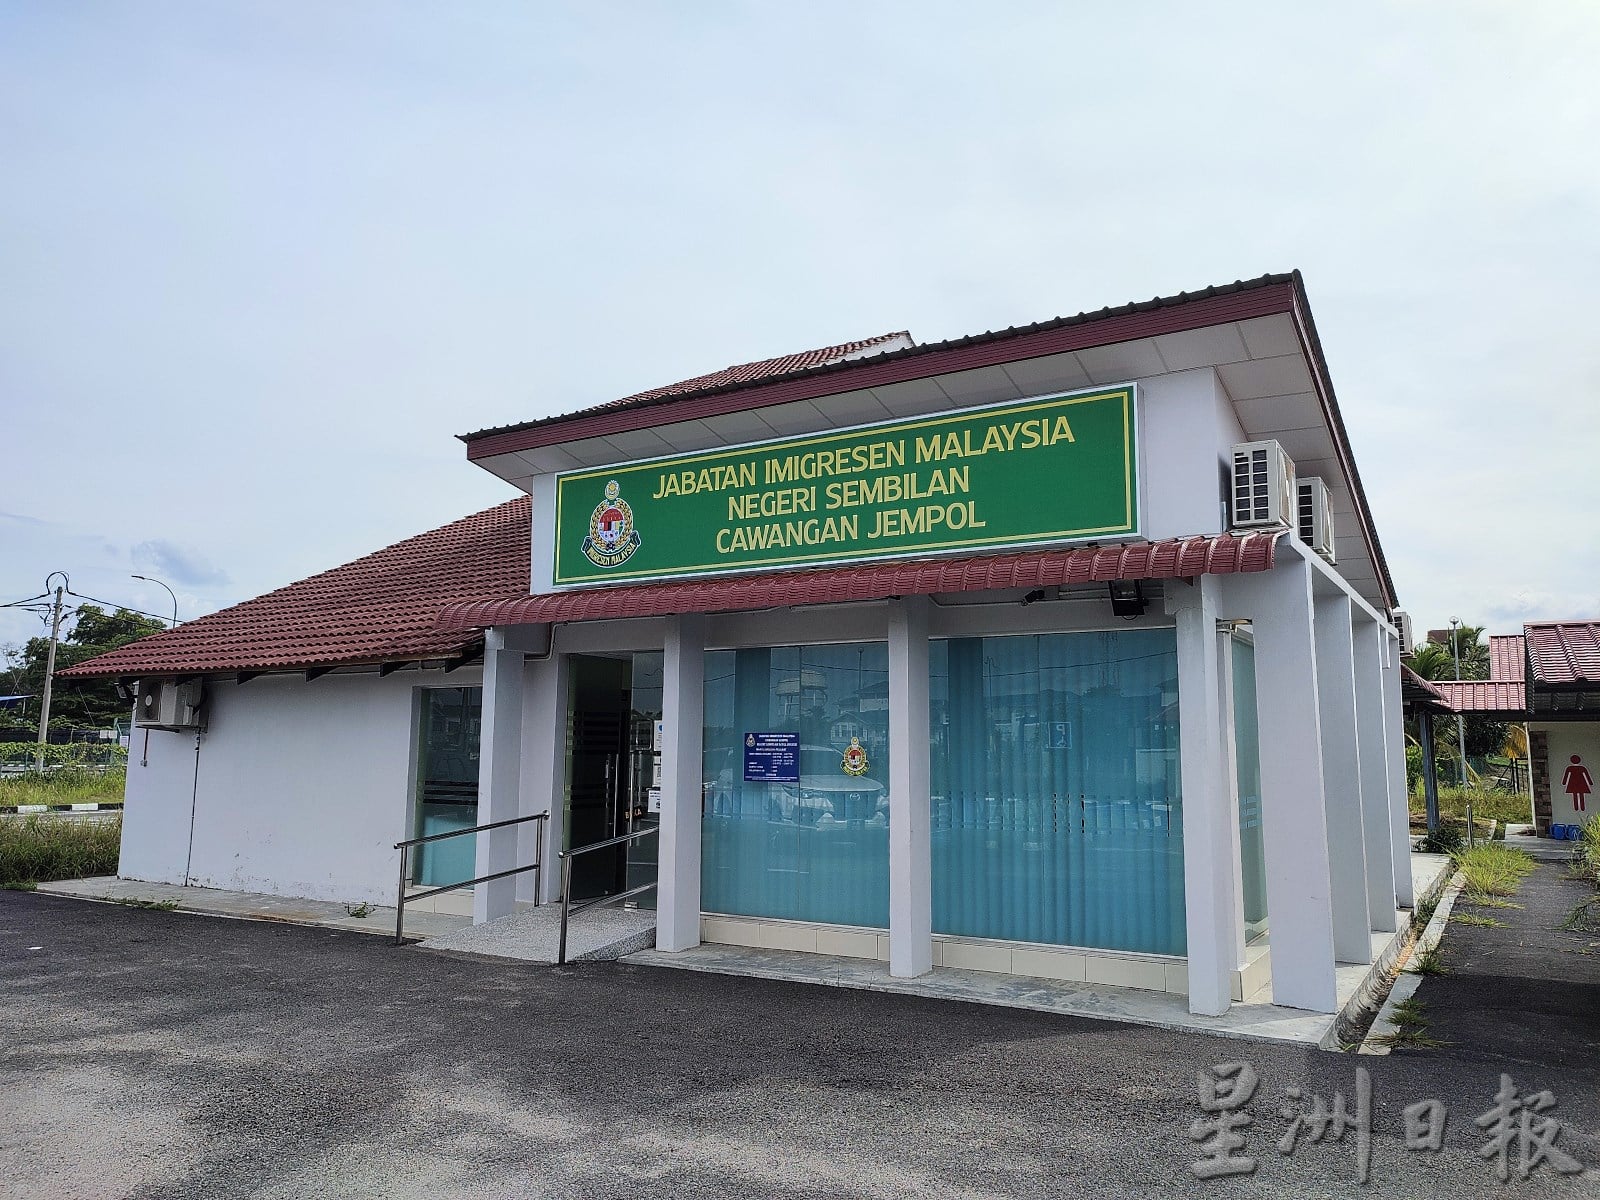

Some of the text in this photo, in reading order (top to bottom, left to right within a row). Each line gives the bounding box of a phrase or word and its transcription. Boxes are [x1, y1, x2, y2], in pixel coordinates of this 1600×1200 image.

[652, 415, 1076, 500] JABATAN IMIGRESEN MALAYSIA
[728, 465, 970, 521] NEGERI SEMBILAN
[716, 500, 987, 554] CAWANGAN JEMPOL
